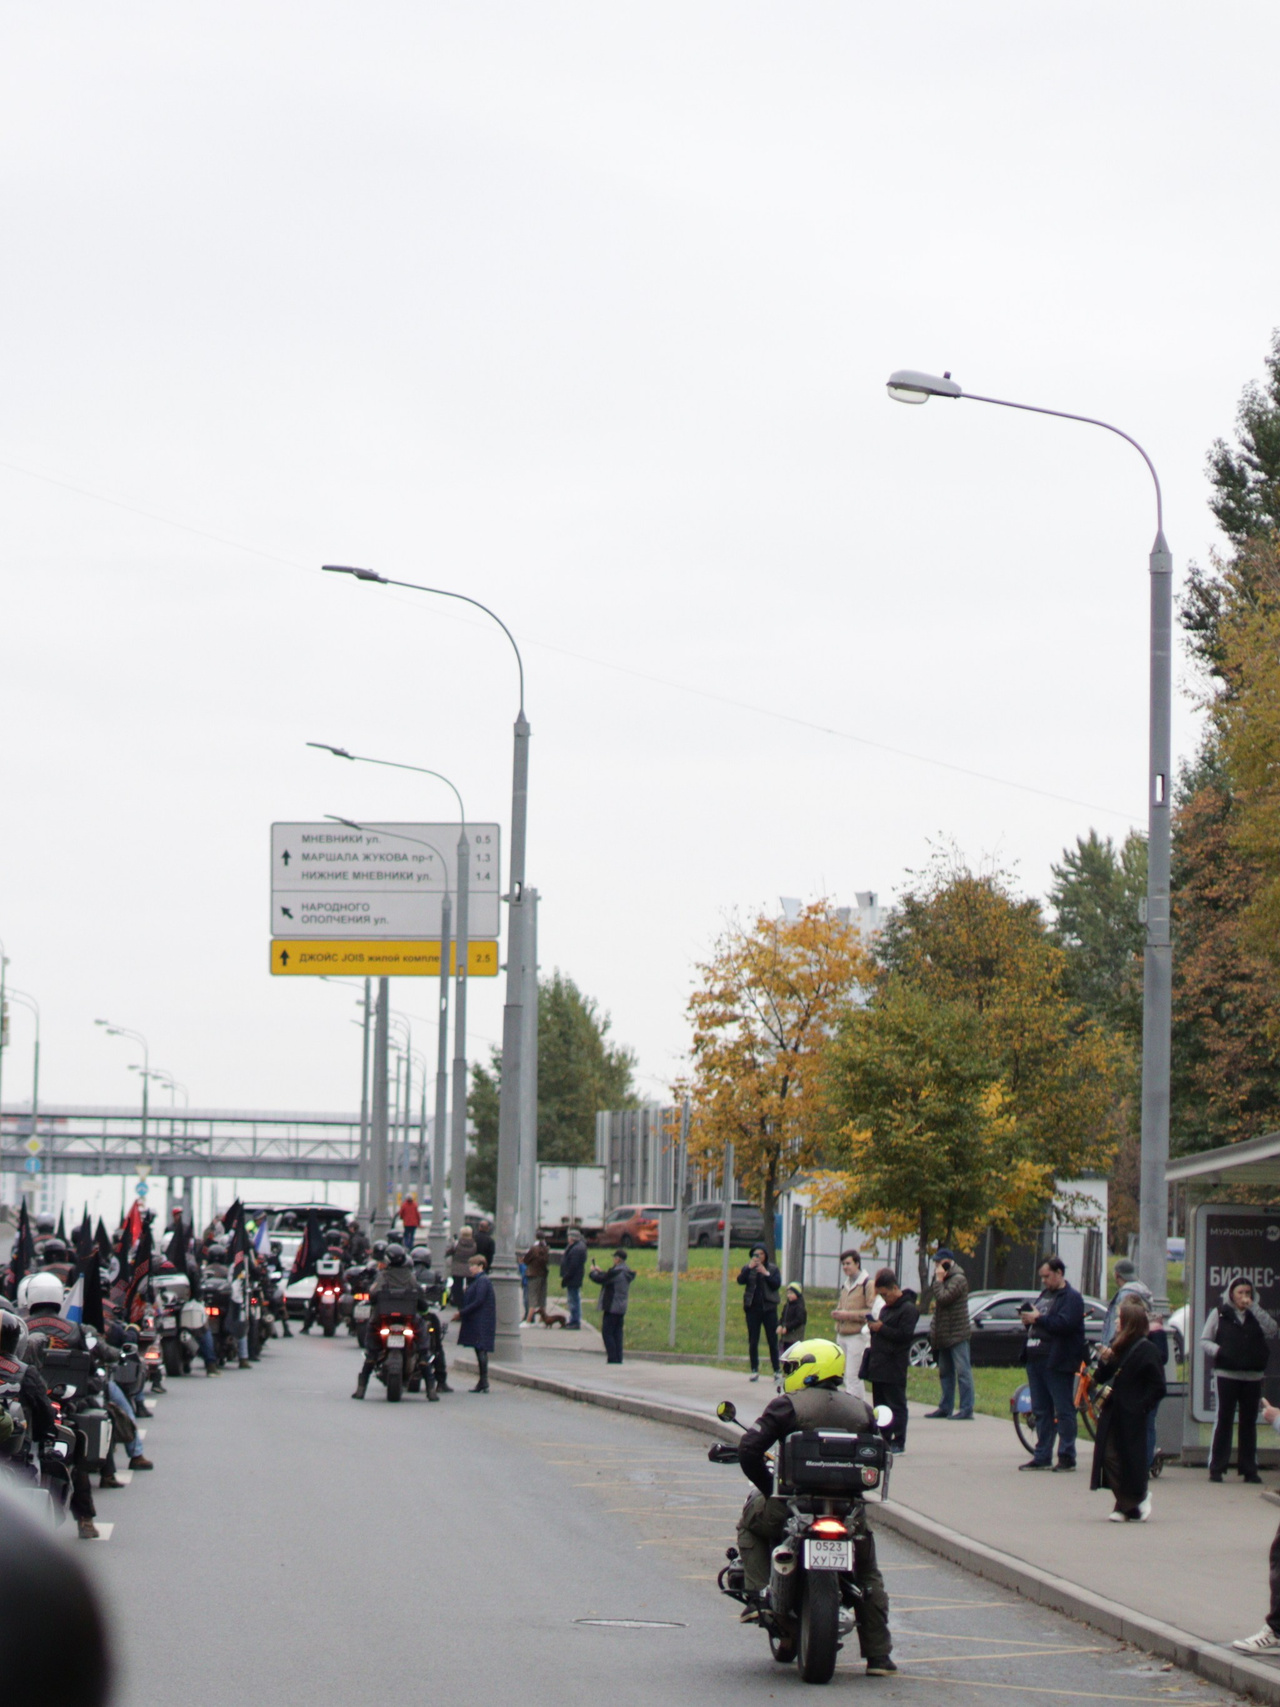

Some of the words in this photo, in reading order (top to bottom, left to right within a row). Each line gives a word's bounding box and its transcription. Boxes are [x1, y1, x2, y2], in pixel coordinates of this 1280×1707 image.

[302, 834, 362, 844] МНЕВНИКИ
[366, 836, 381, 846] ул.
[475, 835, 491, 844] 0.5
[302, 852, 359, 862] МАРШАЛА
[362, 852, 409, 862] ЖУКОВА
[412, 855, 434, 864] пр-т
[476, 853, 491, 862] 1.3
[302, 871, 349, 880] НИЖНИЕ
[352, 871, 413, 881] МНЕВНИКИ
[416, 873, 432, 883] ул.
[476, 872, 491, 881] 1.4
[301, 903, 370, 913] НАРОДНОГО
[301, 915, 370, 924] ОПОЛЧЕНИЯ
[373, 917, 389, 926] ул.
[299, 952, 338, 964] ДЖОЙС
[341, 953, 365, 963] JOIS
[368, 954, 400, 963] жилой
[403, 955, 441, 963] компле
[476, 954, 491, 963] 2.5
[1210, 1227, 1263, 1237] MYPRIORITY
[815, 1542, 842, 1552] 0523
[832, 1556, 845, 1566] 77
